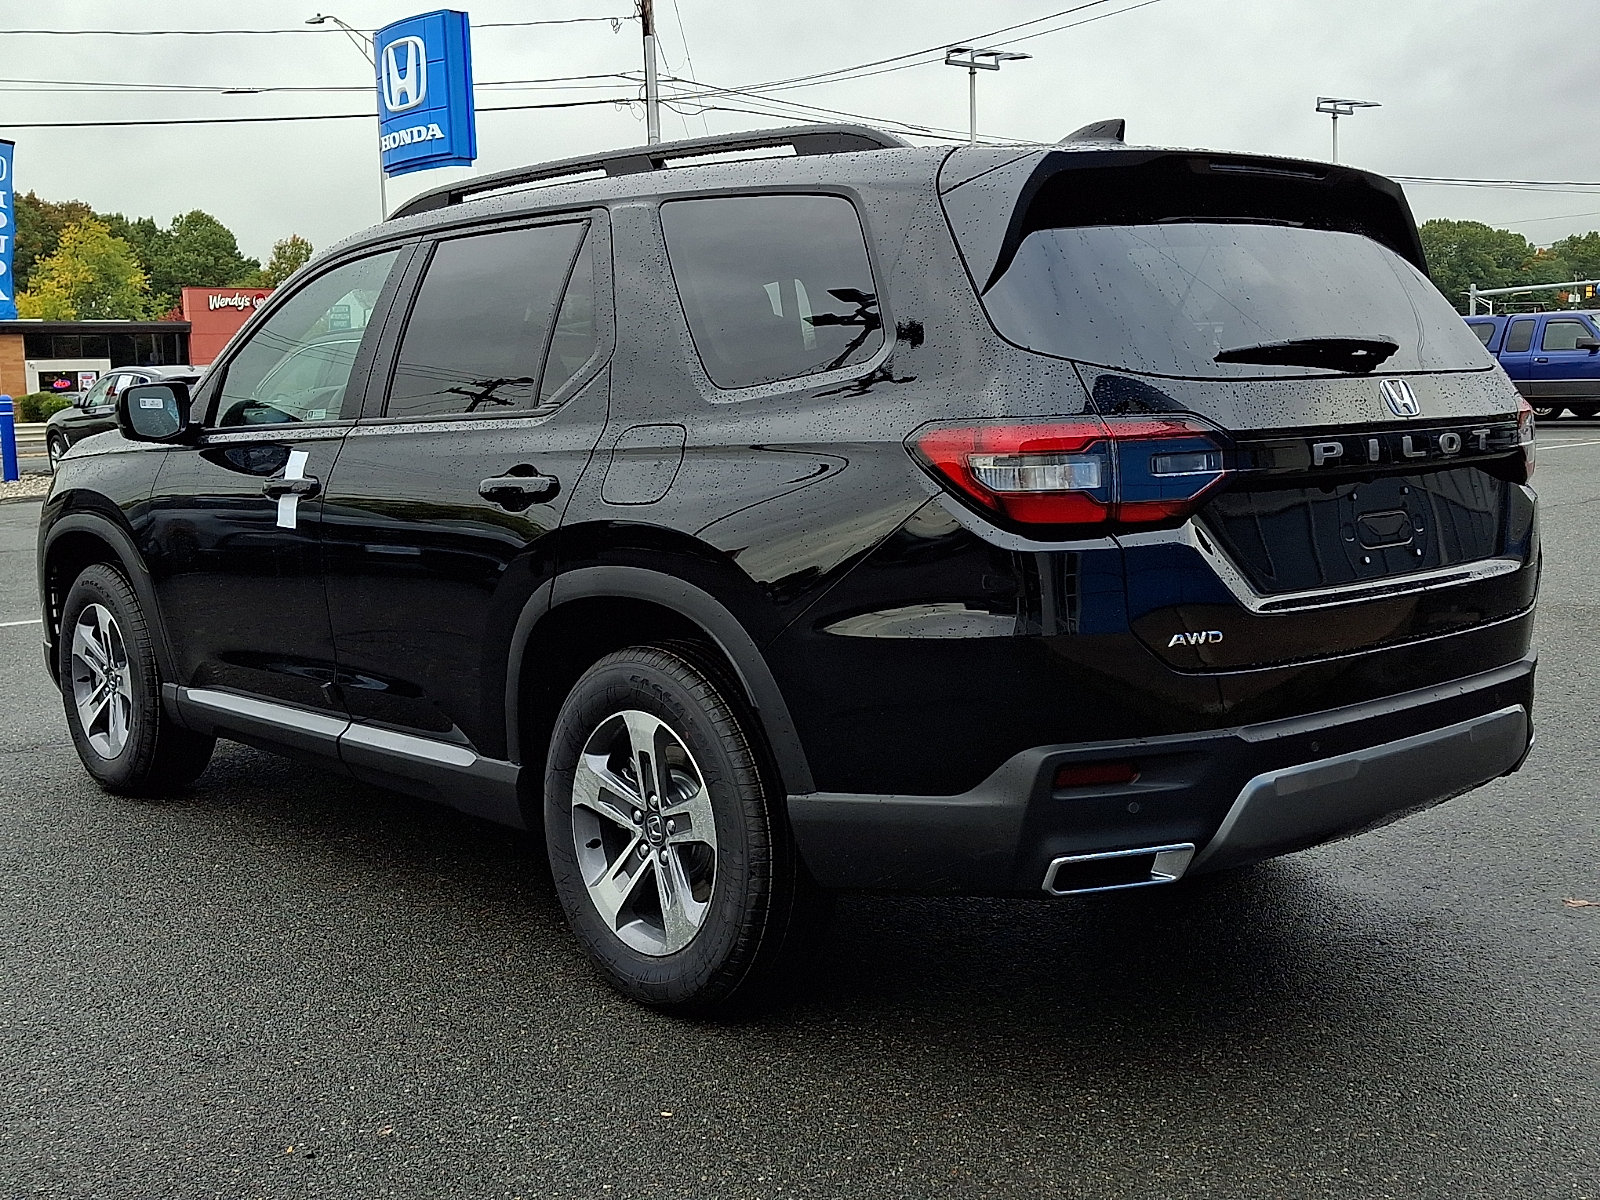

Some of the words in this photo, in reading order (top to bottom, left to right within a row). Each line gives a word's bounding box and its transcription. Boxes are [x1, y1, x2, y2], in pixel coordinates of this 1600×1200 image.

[380, 123, 445, 152] HONDA
[208, 292, 251, 311] Wendy's
[1313, 429, 1491, 466] PILOT
[1168, 631, 1223, 648] AWD
